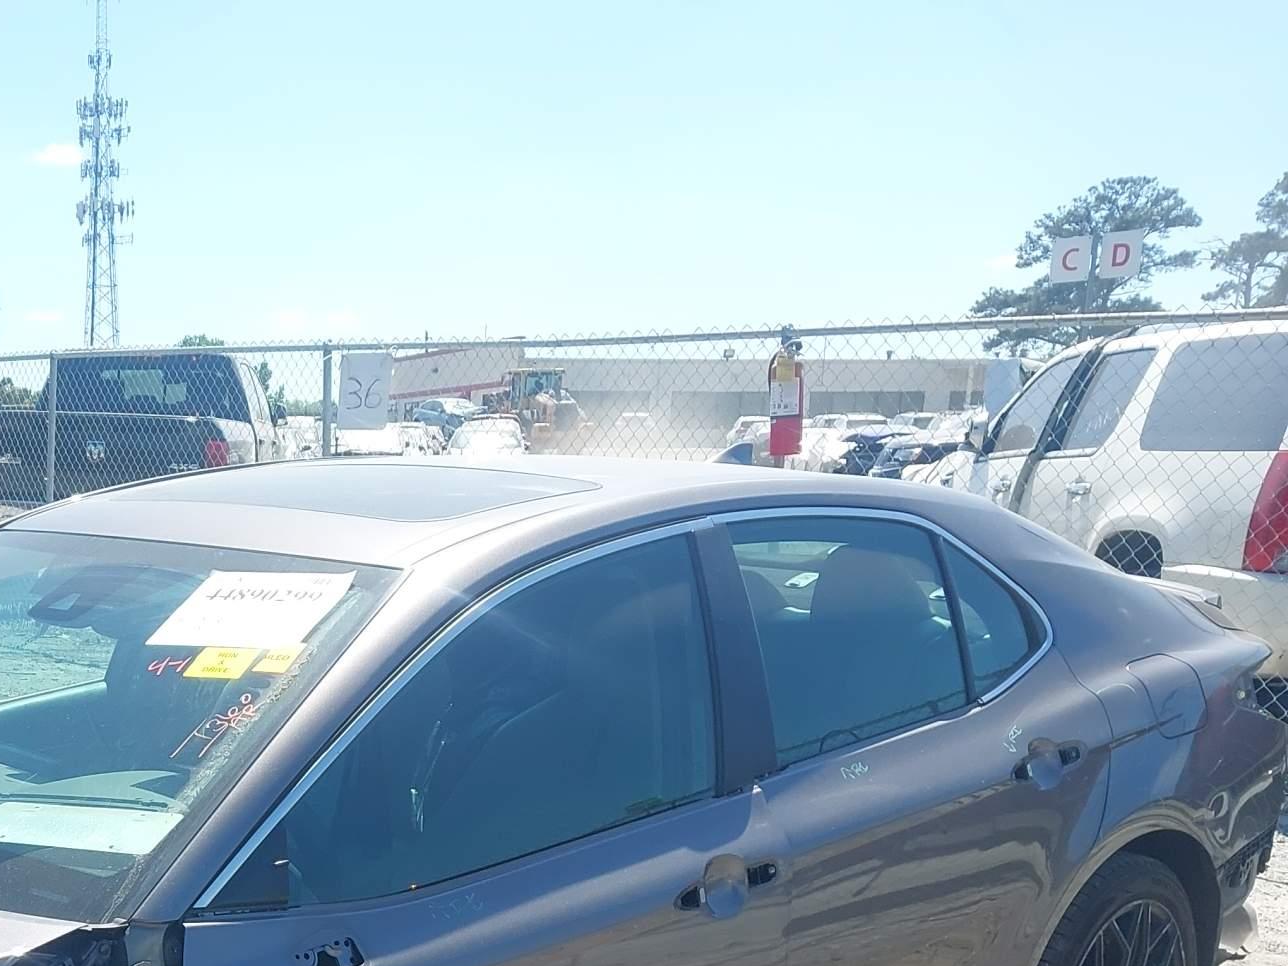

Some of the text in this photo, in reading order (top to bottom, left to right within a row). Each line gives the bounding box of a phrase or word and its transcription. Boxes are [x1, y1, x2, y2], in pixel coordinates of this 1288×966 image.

[1062, 248, 1080, 271] C
[1112, 243, 1131, 267] D
[345, 377, 382, 410] 36
